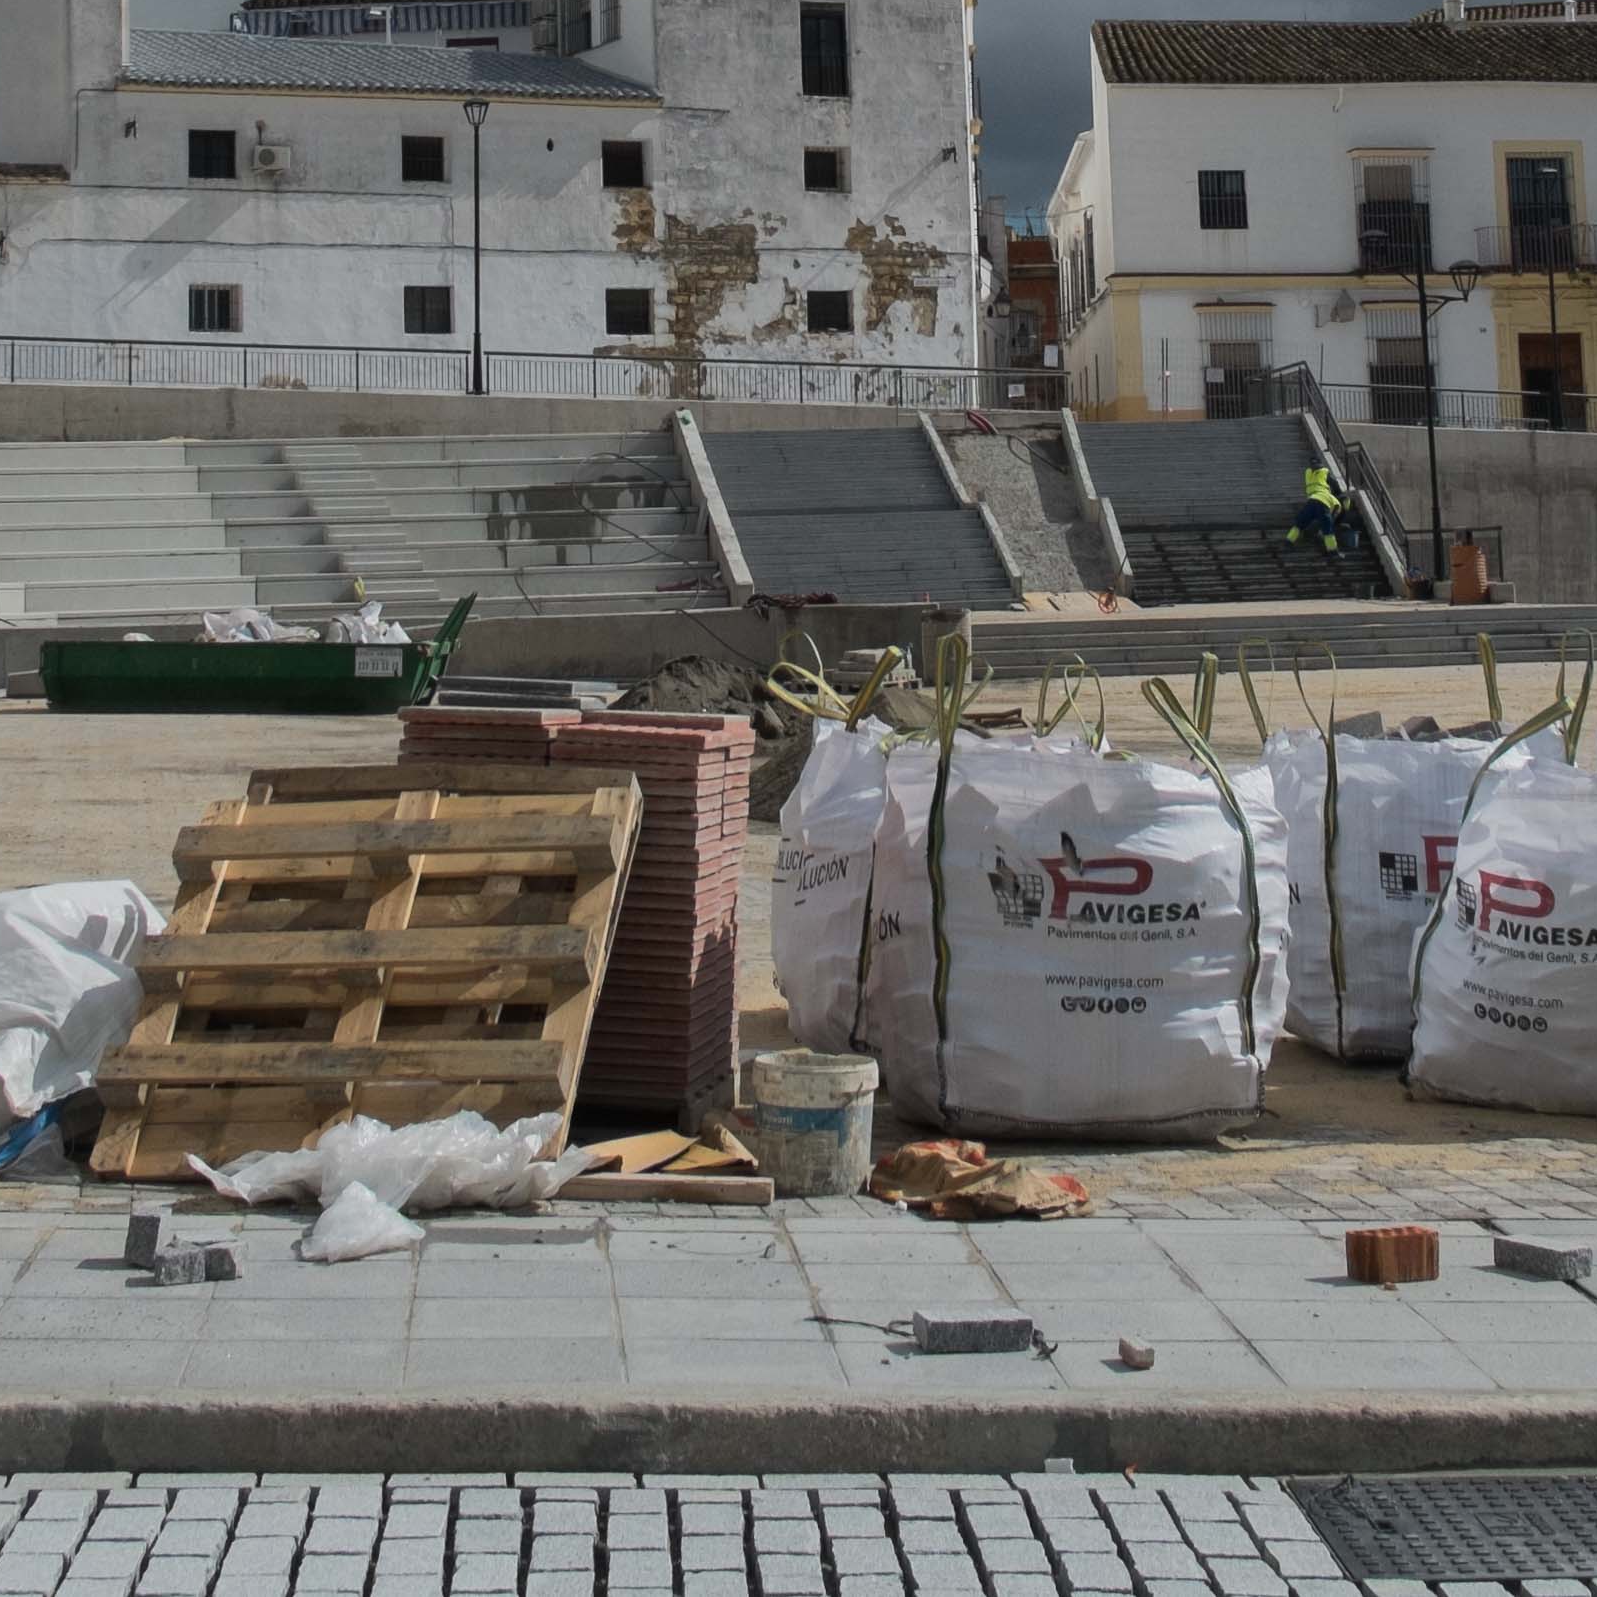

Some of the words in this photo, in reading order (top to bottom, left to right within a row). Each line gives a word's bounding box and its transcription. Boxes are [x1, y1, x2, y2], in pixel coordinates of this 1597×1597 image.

[1037, 857, 1202, 922] PAVIGESA
[1047, 925, 1117, 942] Pavimentos
[1528, 951, 1544, 963] del
[1547, 952, 1577, 965] Genil,
[1045, 973, 1164, 991] www.pavigesa.com
[1463, 978, 1564, 1010] www.pavigesa.com
